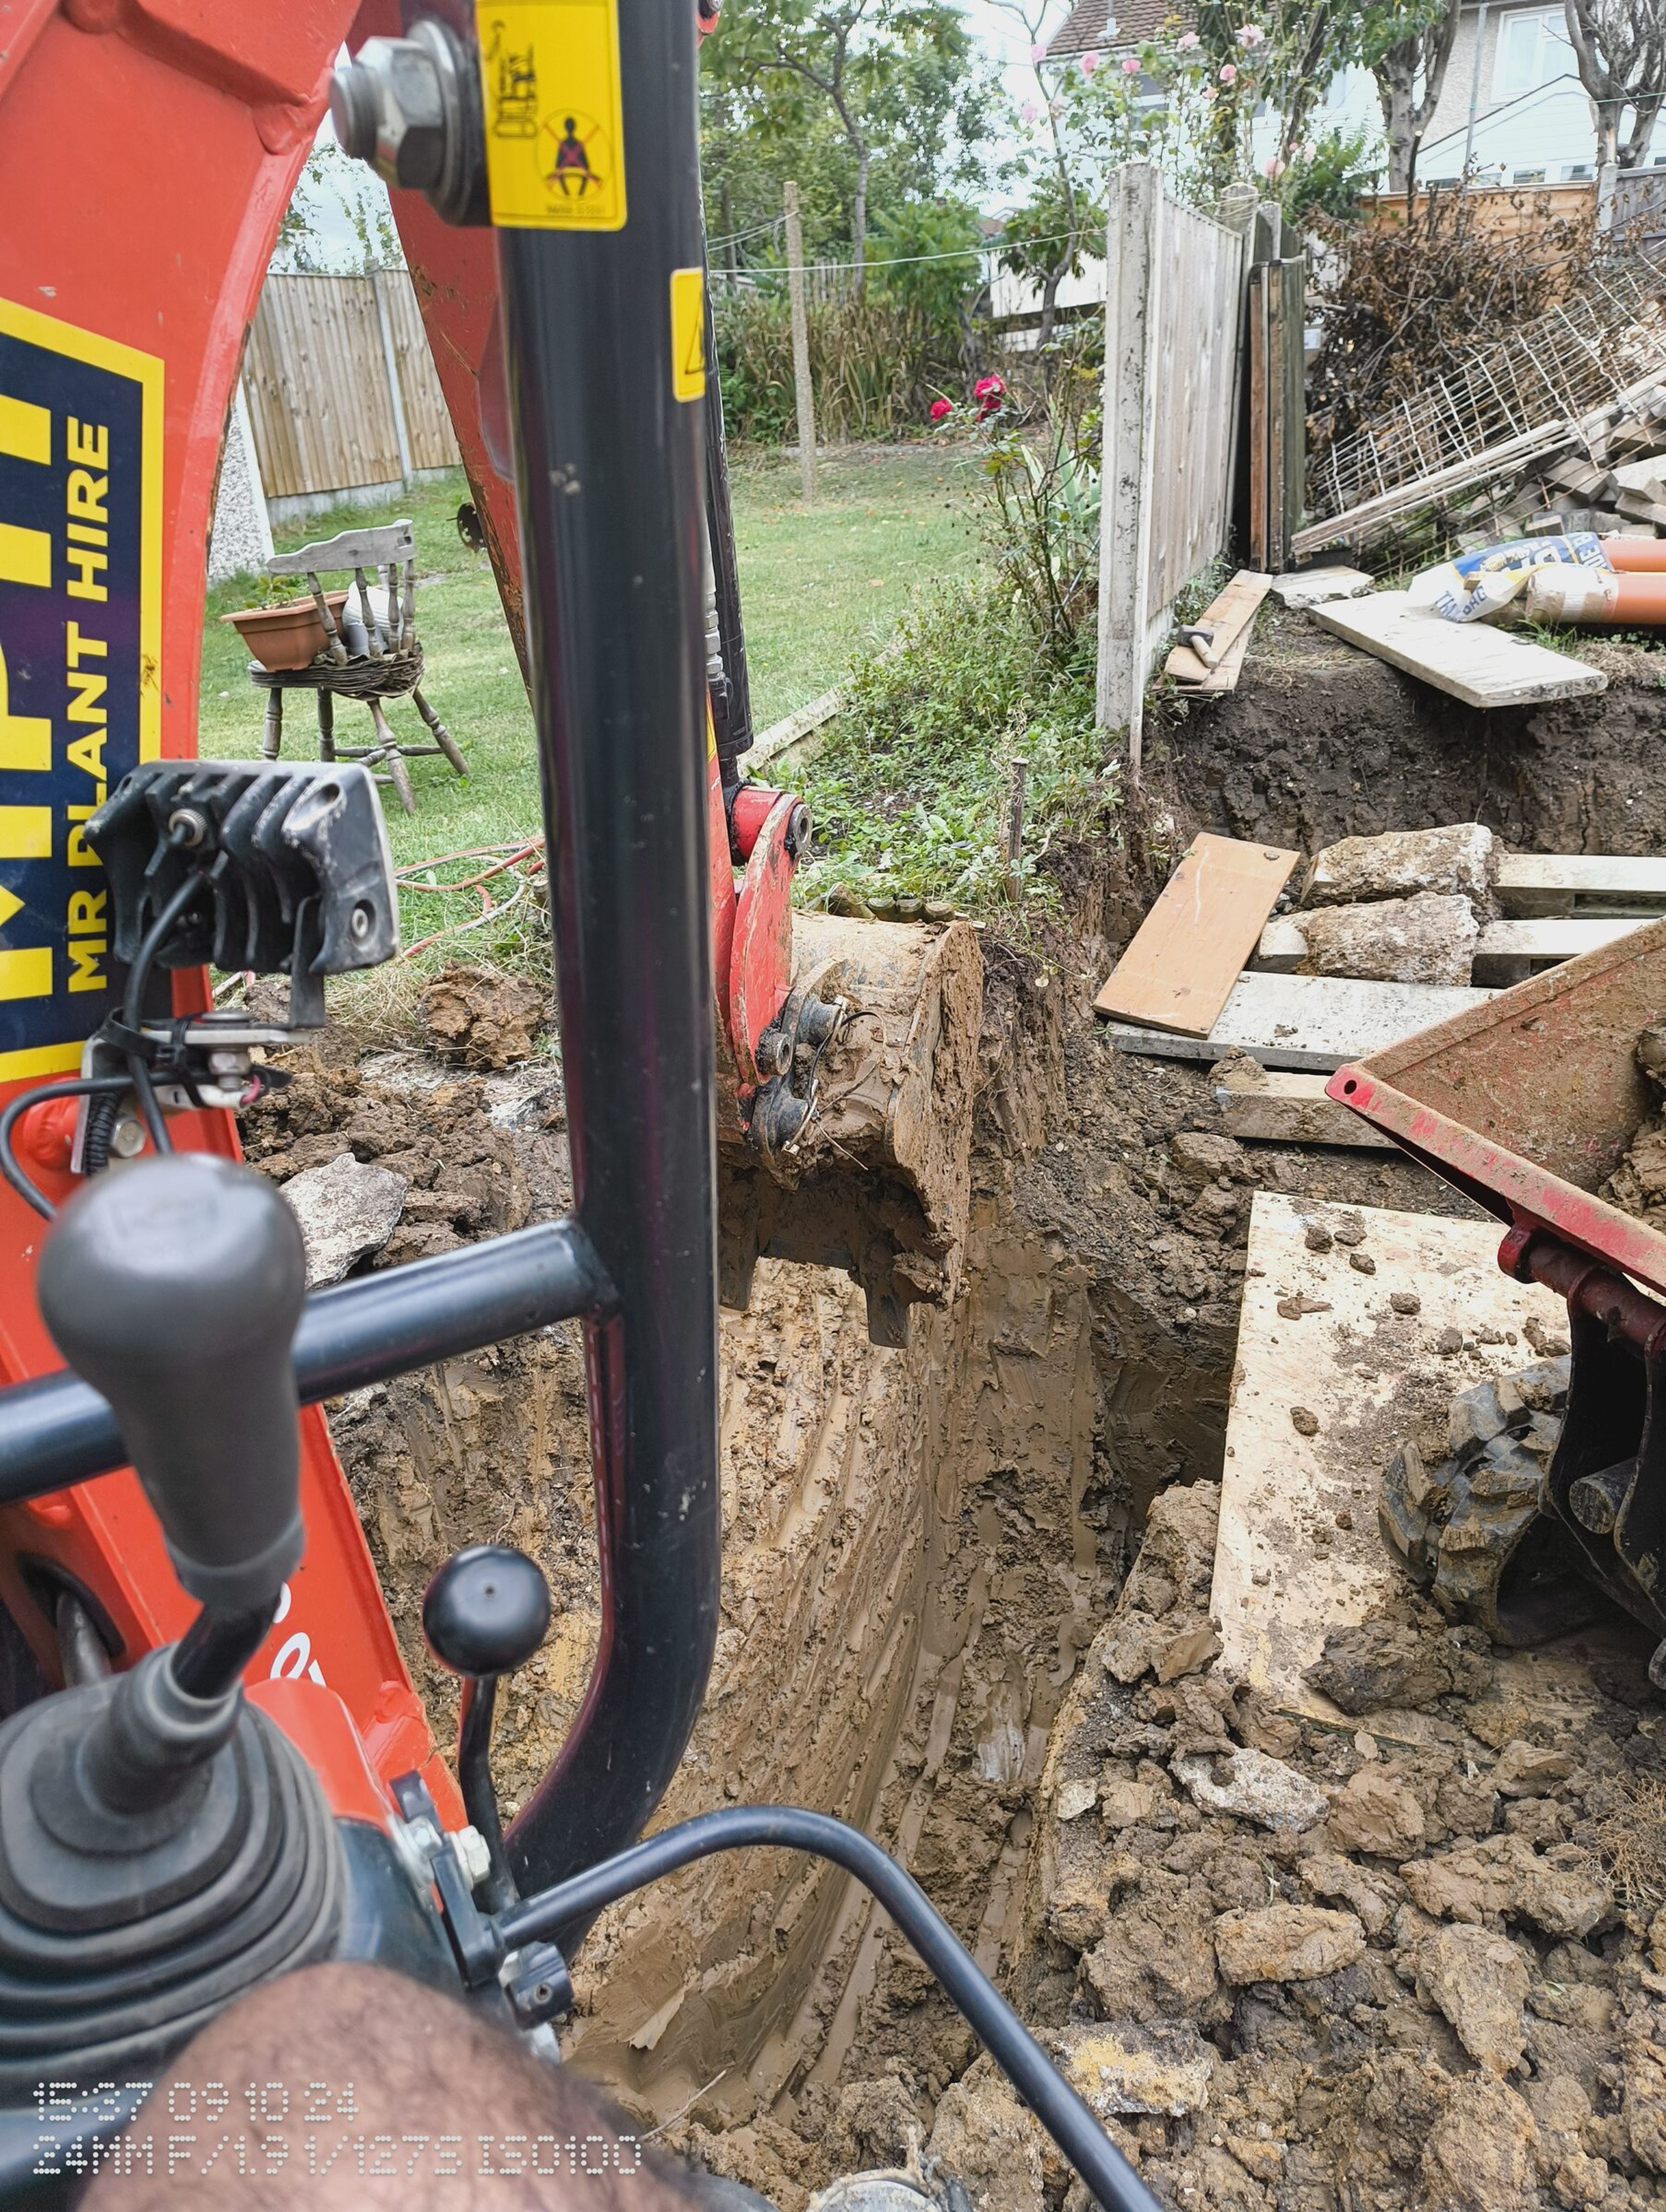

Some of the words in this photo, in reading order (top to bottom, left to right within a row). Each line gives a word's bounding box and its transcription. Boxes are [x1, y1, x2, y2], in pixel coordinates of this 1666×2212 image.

[67, 416, 108, 602] HIRE
[67, 620, 108, 867] PLANT
[68, 889, 107, 992] MR
